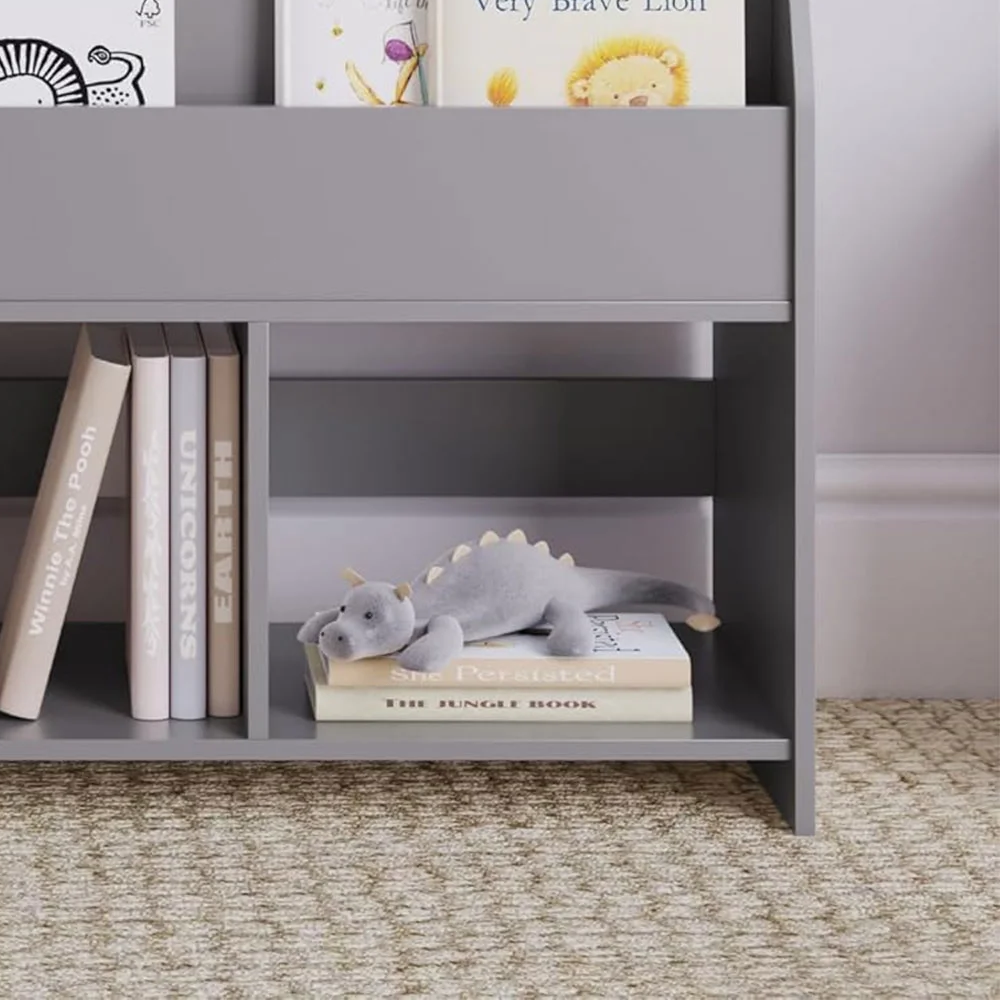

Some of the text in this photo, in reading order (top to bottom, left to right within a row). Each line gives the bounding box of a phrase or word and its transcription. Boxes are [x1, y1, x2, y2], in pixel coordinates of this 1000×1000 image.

[28, 424, 97, 637] Winnie The Pooh
[180, 429, 197, 659] UNICORNS
[214, 440, 233, 624] EARTH
[386, 698, 597, 709] THE JUNGLE BOOK
[457, 665, 615, 682] Persisted
